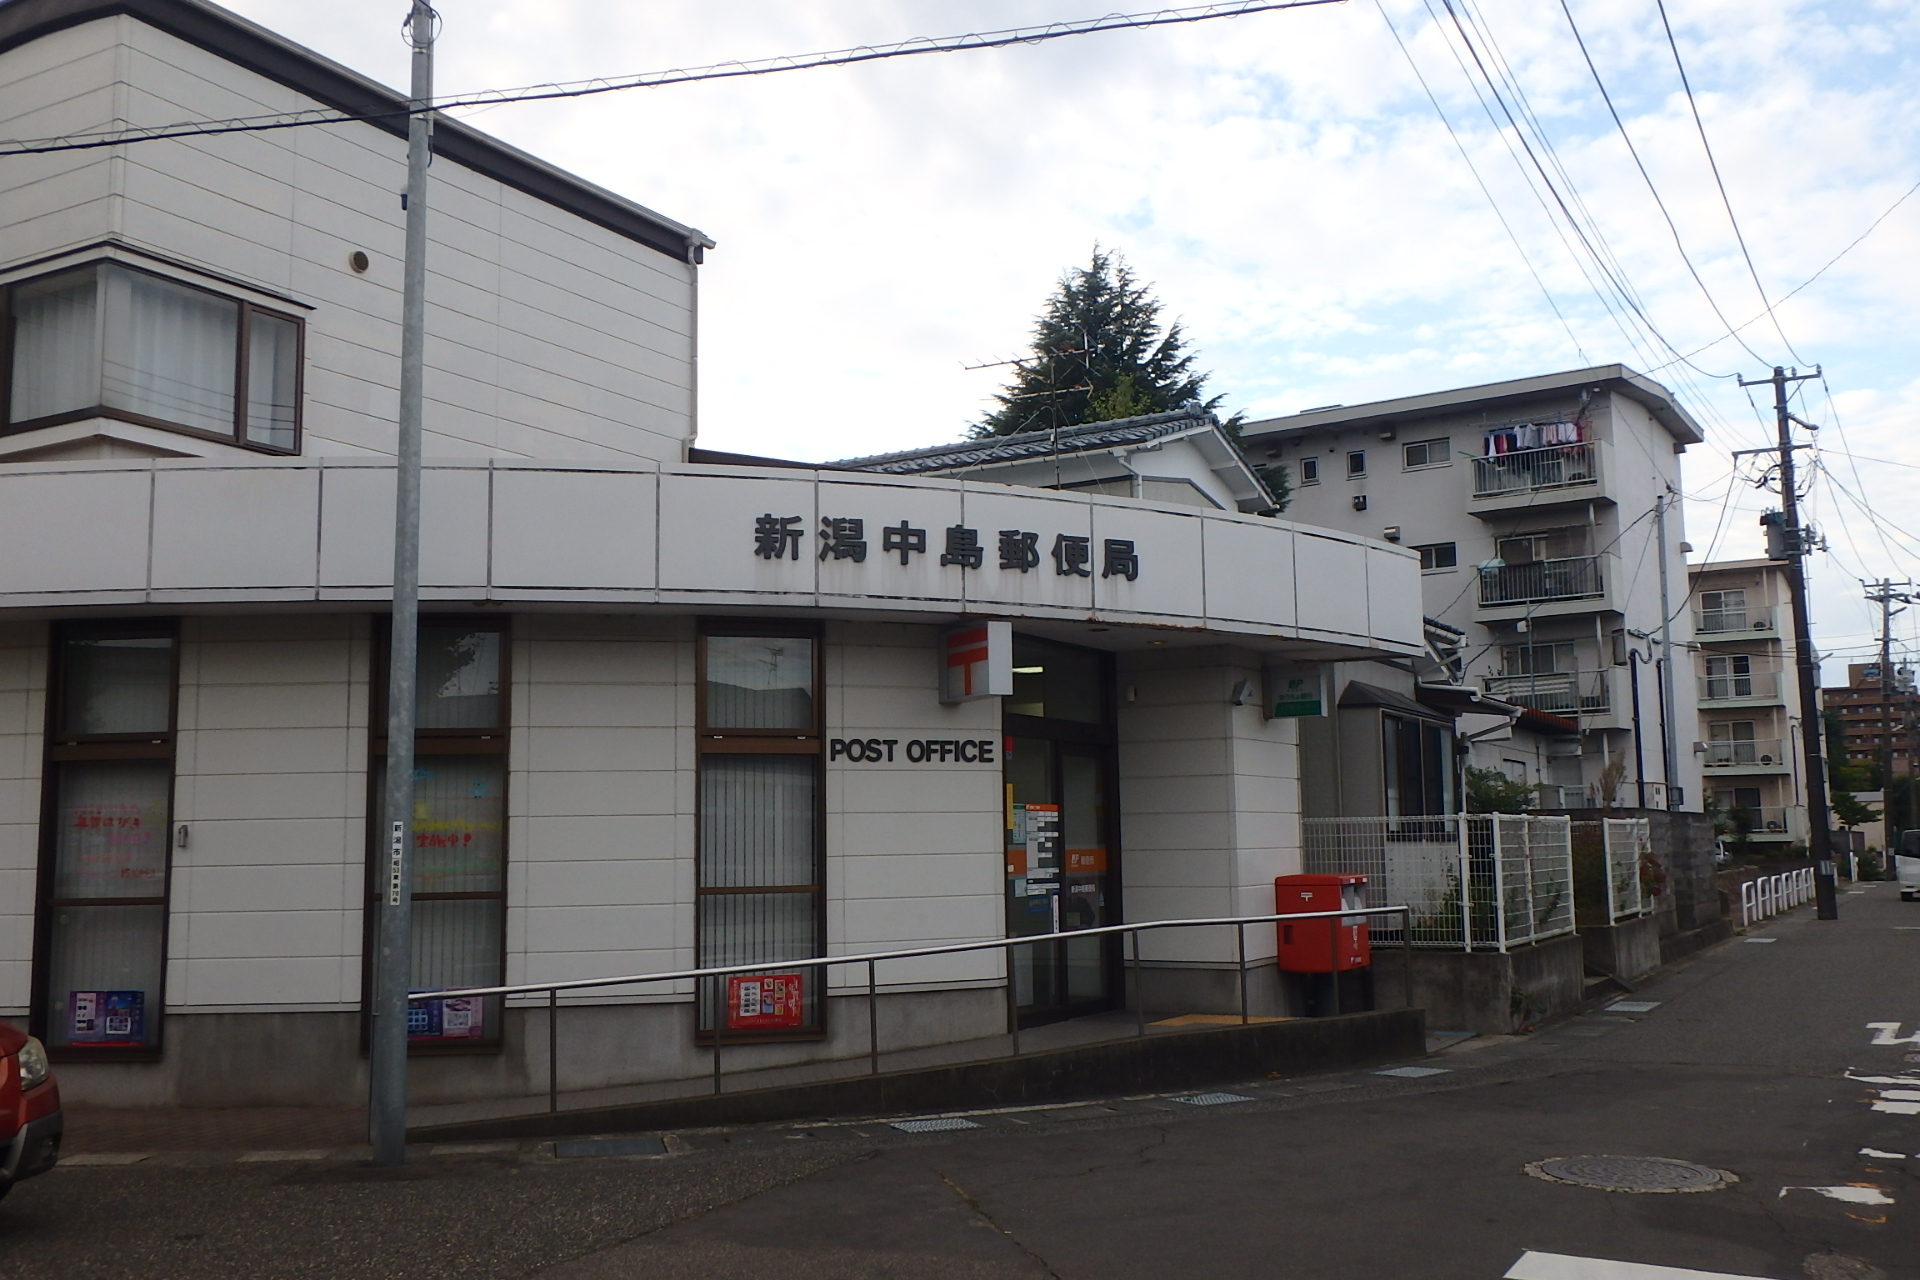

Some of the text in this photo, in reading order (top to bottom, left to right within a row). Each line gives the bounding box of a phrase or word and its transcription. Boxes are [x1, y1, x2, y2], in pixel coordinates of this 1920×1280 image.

[754, 513, 1139, 581] 新潟中島郵便局
[830, 738, 994, 763] POST OFFICE
[393, 824, 402, 856] 新潟市
